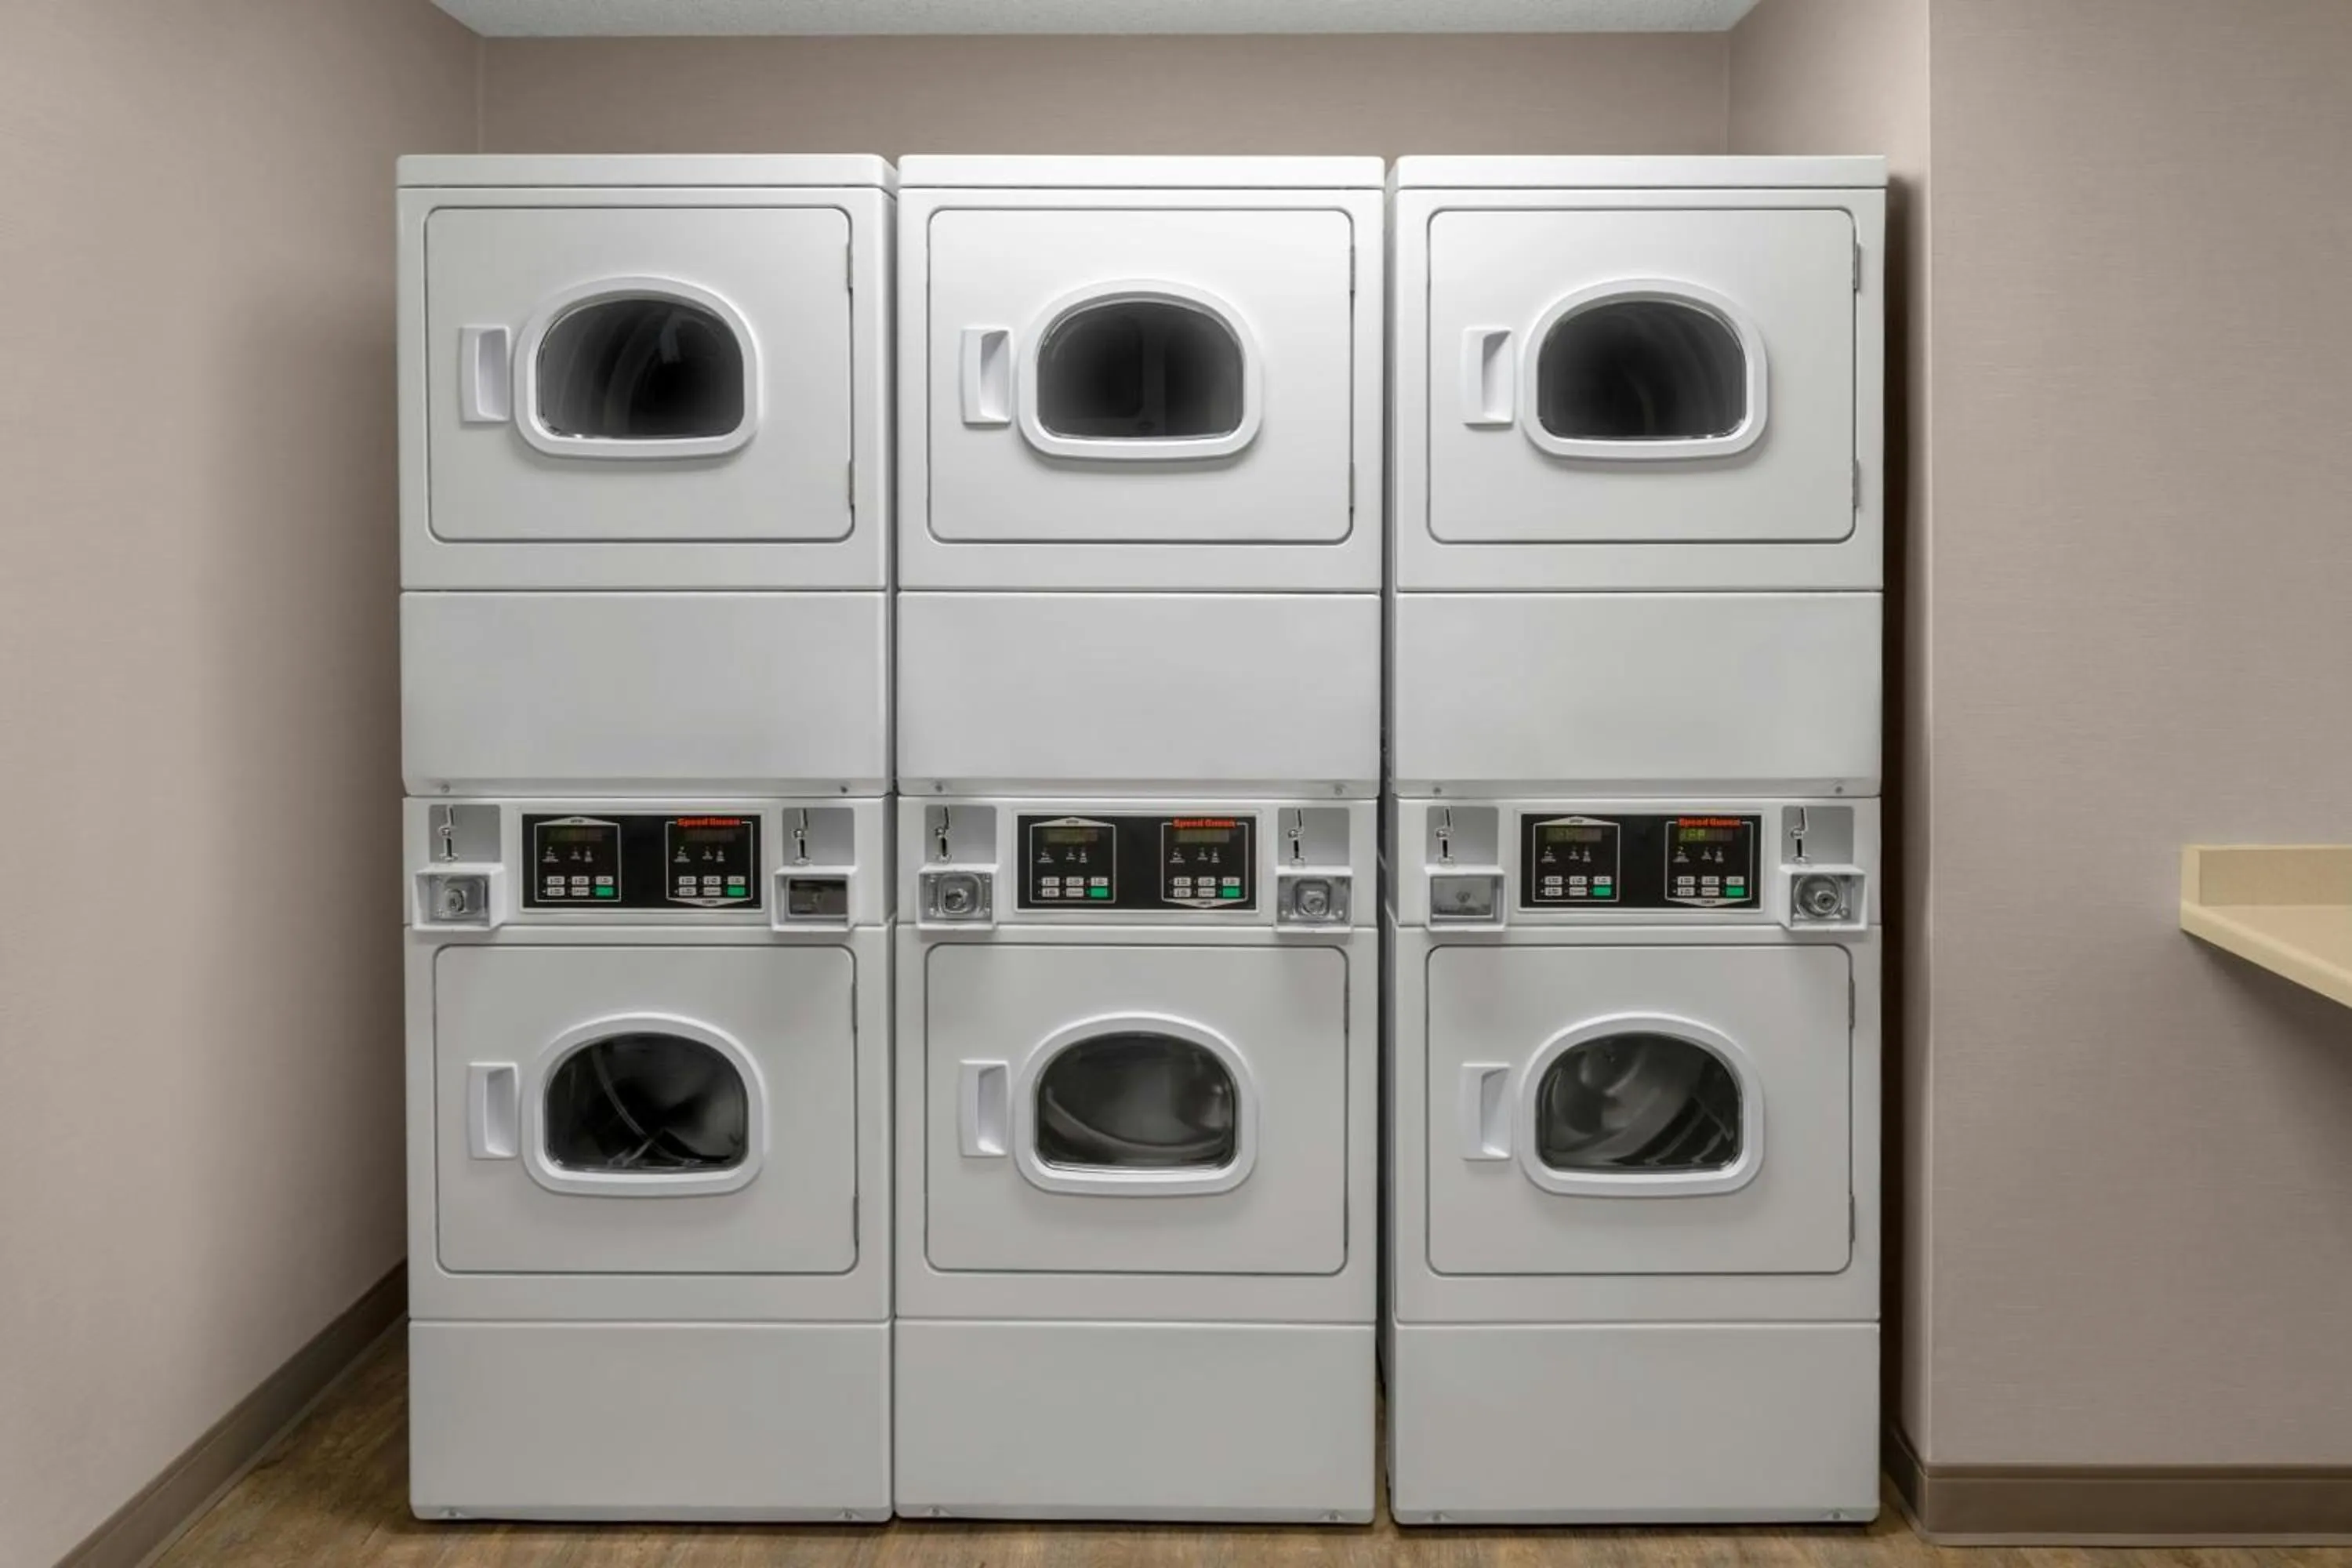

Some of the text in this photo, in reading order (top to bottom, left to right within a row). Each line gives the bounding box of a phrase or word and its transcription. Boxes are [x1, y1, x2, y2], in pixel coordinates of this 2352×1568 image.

[677, 818, 707, 827] Speed
[1173, 818, 1203, 828] Speed
[1679, 818, 1708, 827] Speed
